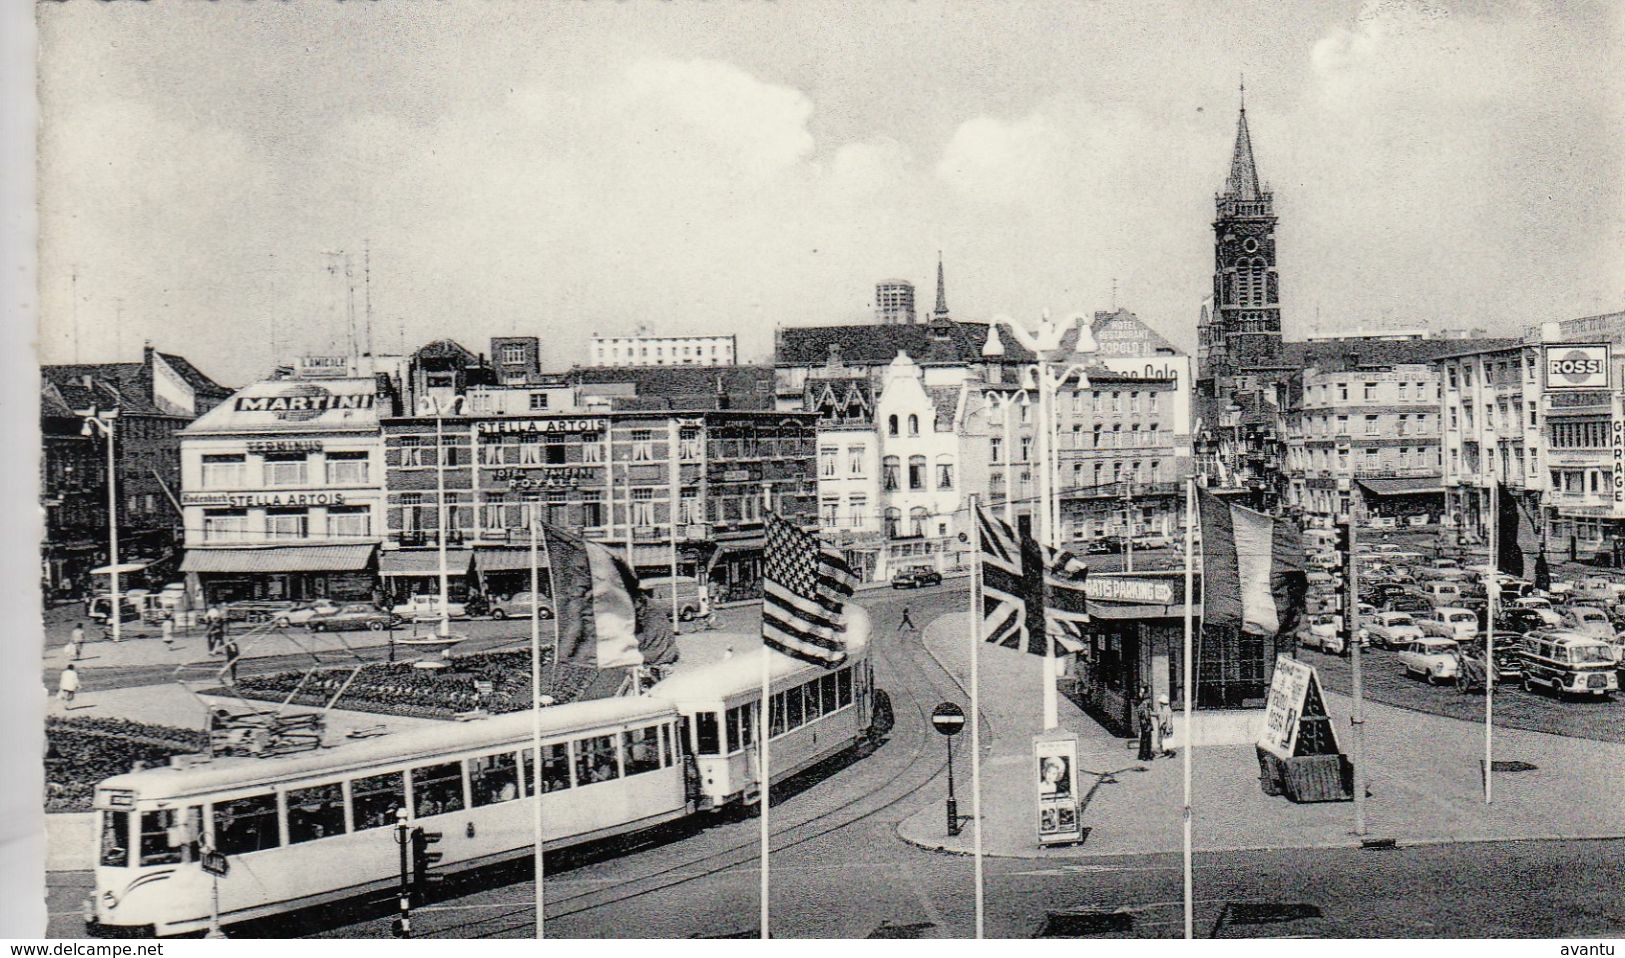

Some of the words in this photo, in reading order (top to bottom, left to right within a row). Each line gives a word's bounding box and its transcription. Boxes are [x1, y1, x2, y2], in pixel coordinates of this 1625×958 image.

[1100, 341, 1139, 354] EOPOLD
[1550, 359, 1603, 374] ROSSI
[239, 394, 370, 411] MARTINI
[477, 421, 538, 433] STELLA
[547, 420, 606, 432] ARTOIS
[246, 440, 324, 452] TERMINUS
[1613, 420, 1623, 502] GARAGE
[508, 478, 578, 488] ROYALE
[228, 494, 282, 507] STELLA
[287, 493, 344, 505] ARTOIS
[1113, 580, 1154, 600] PARKING
